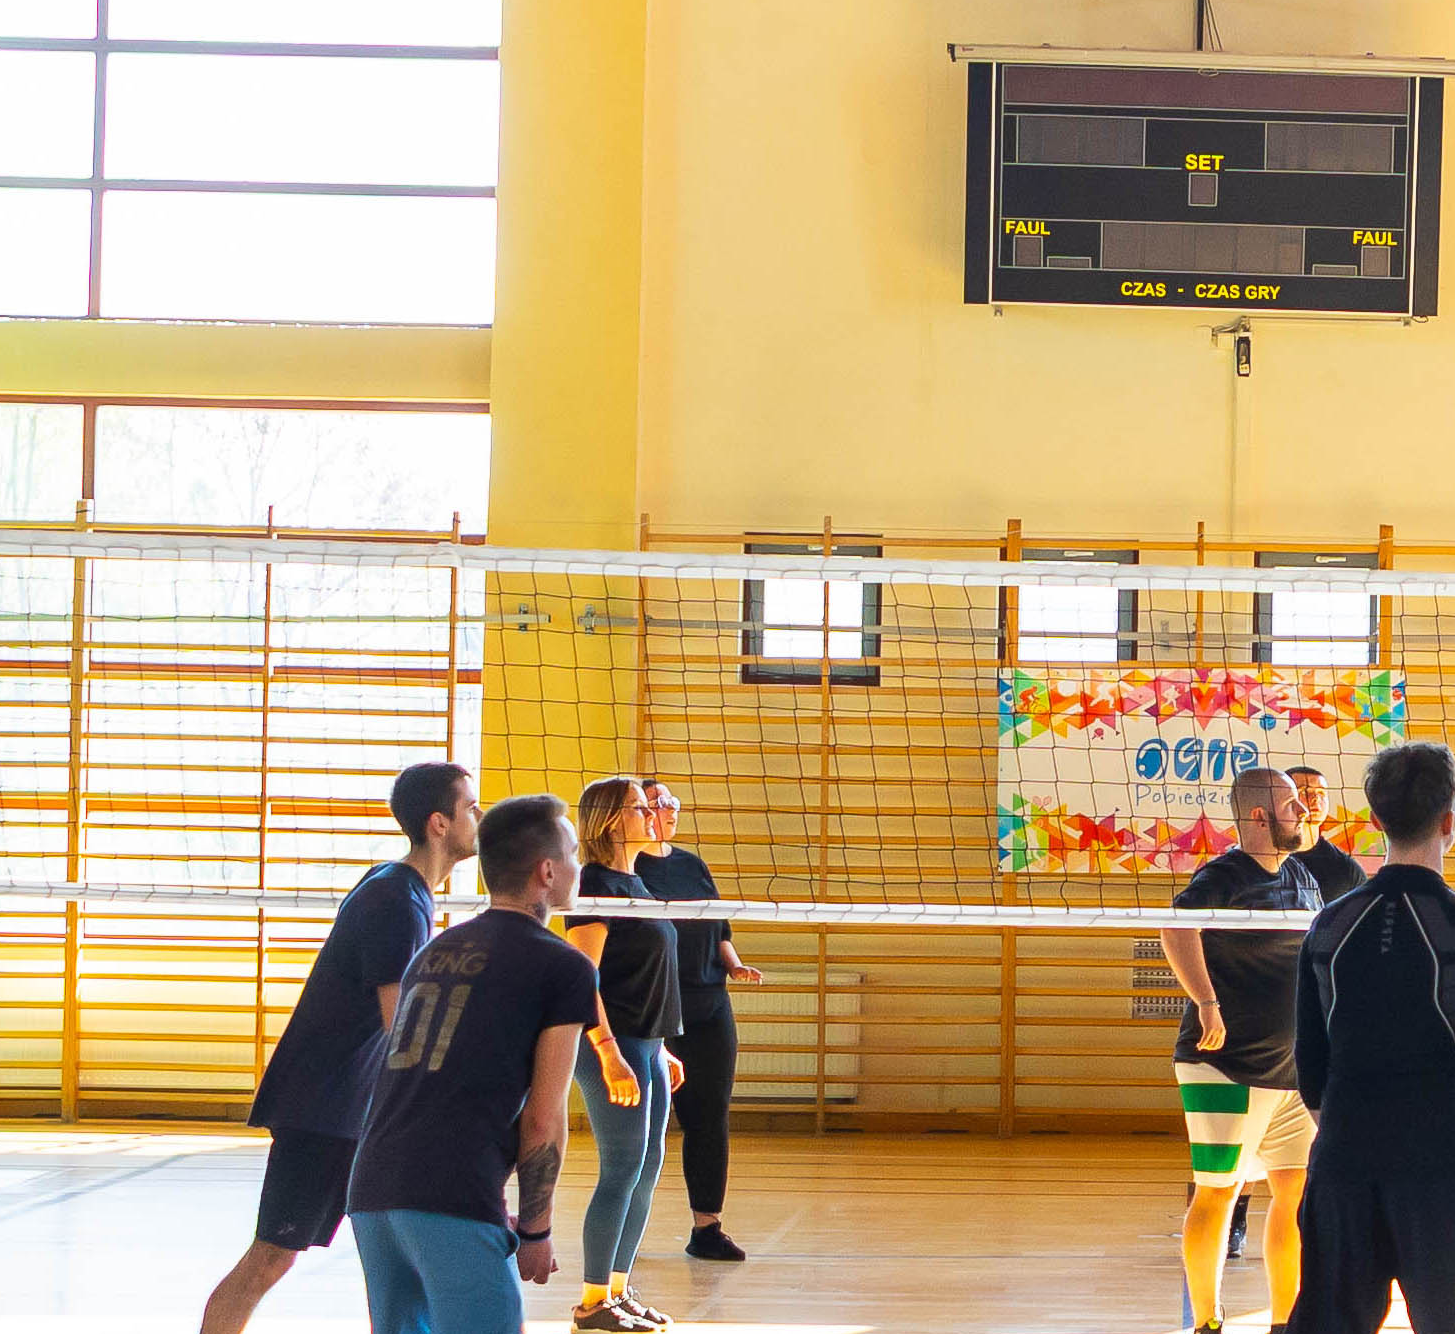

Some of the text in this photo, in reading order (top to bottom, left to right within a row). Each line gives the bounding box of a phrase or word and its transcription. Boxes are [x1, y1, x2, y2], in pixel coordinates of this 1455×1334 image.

[1185, 154, 1224, 170] SET
[1005, 220, 1050, 236] FAUL
[1352, 230, 1398, 246] FAUL
[1120, 281, 1167, 298] CZAS
[1194, 283, 1241, 299] CZAS
[1244, 285, 1281, 301] GRY
[1134, 784, 1232, 807] Pobiedzis
[417, 950, 488, 976] KING
[387, 981, 472, 1071] 01
